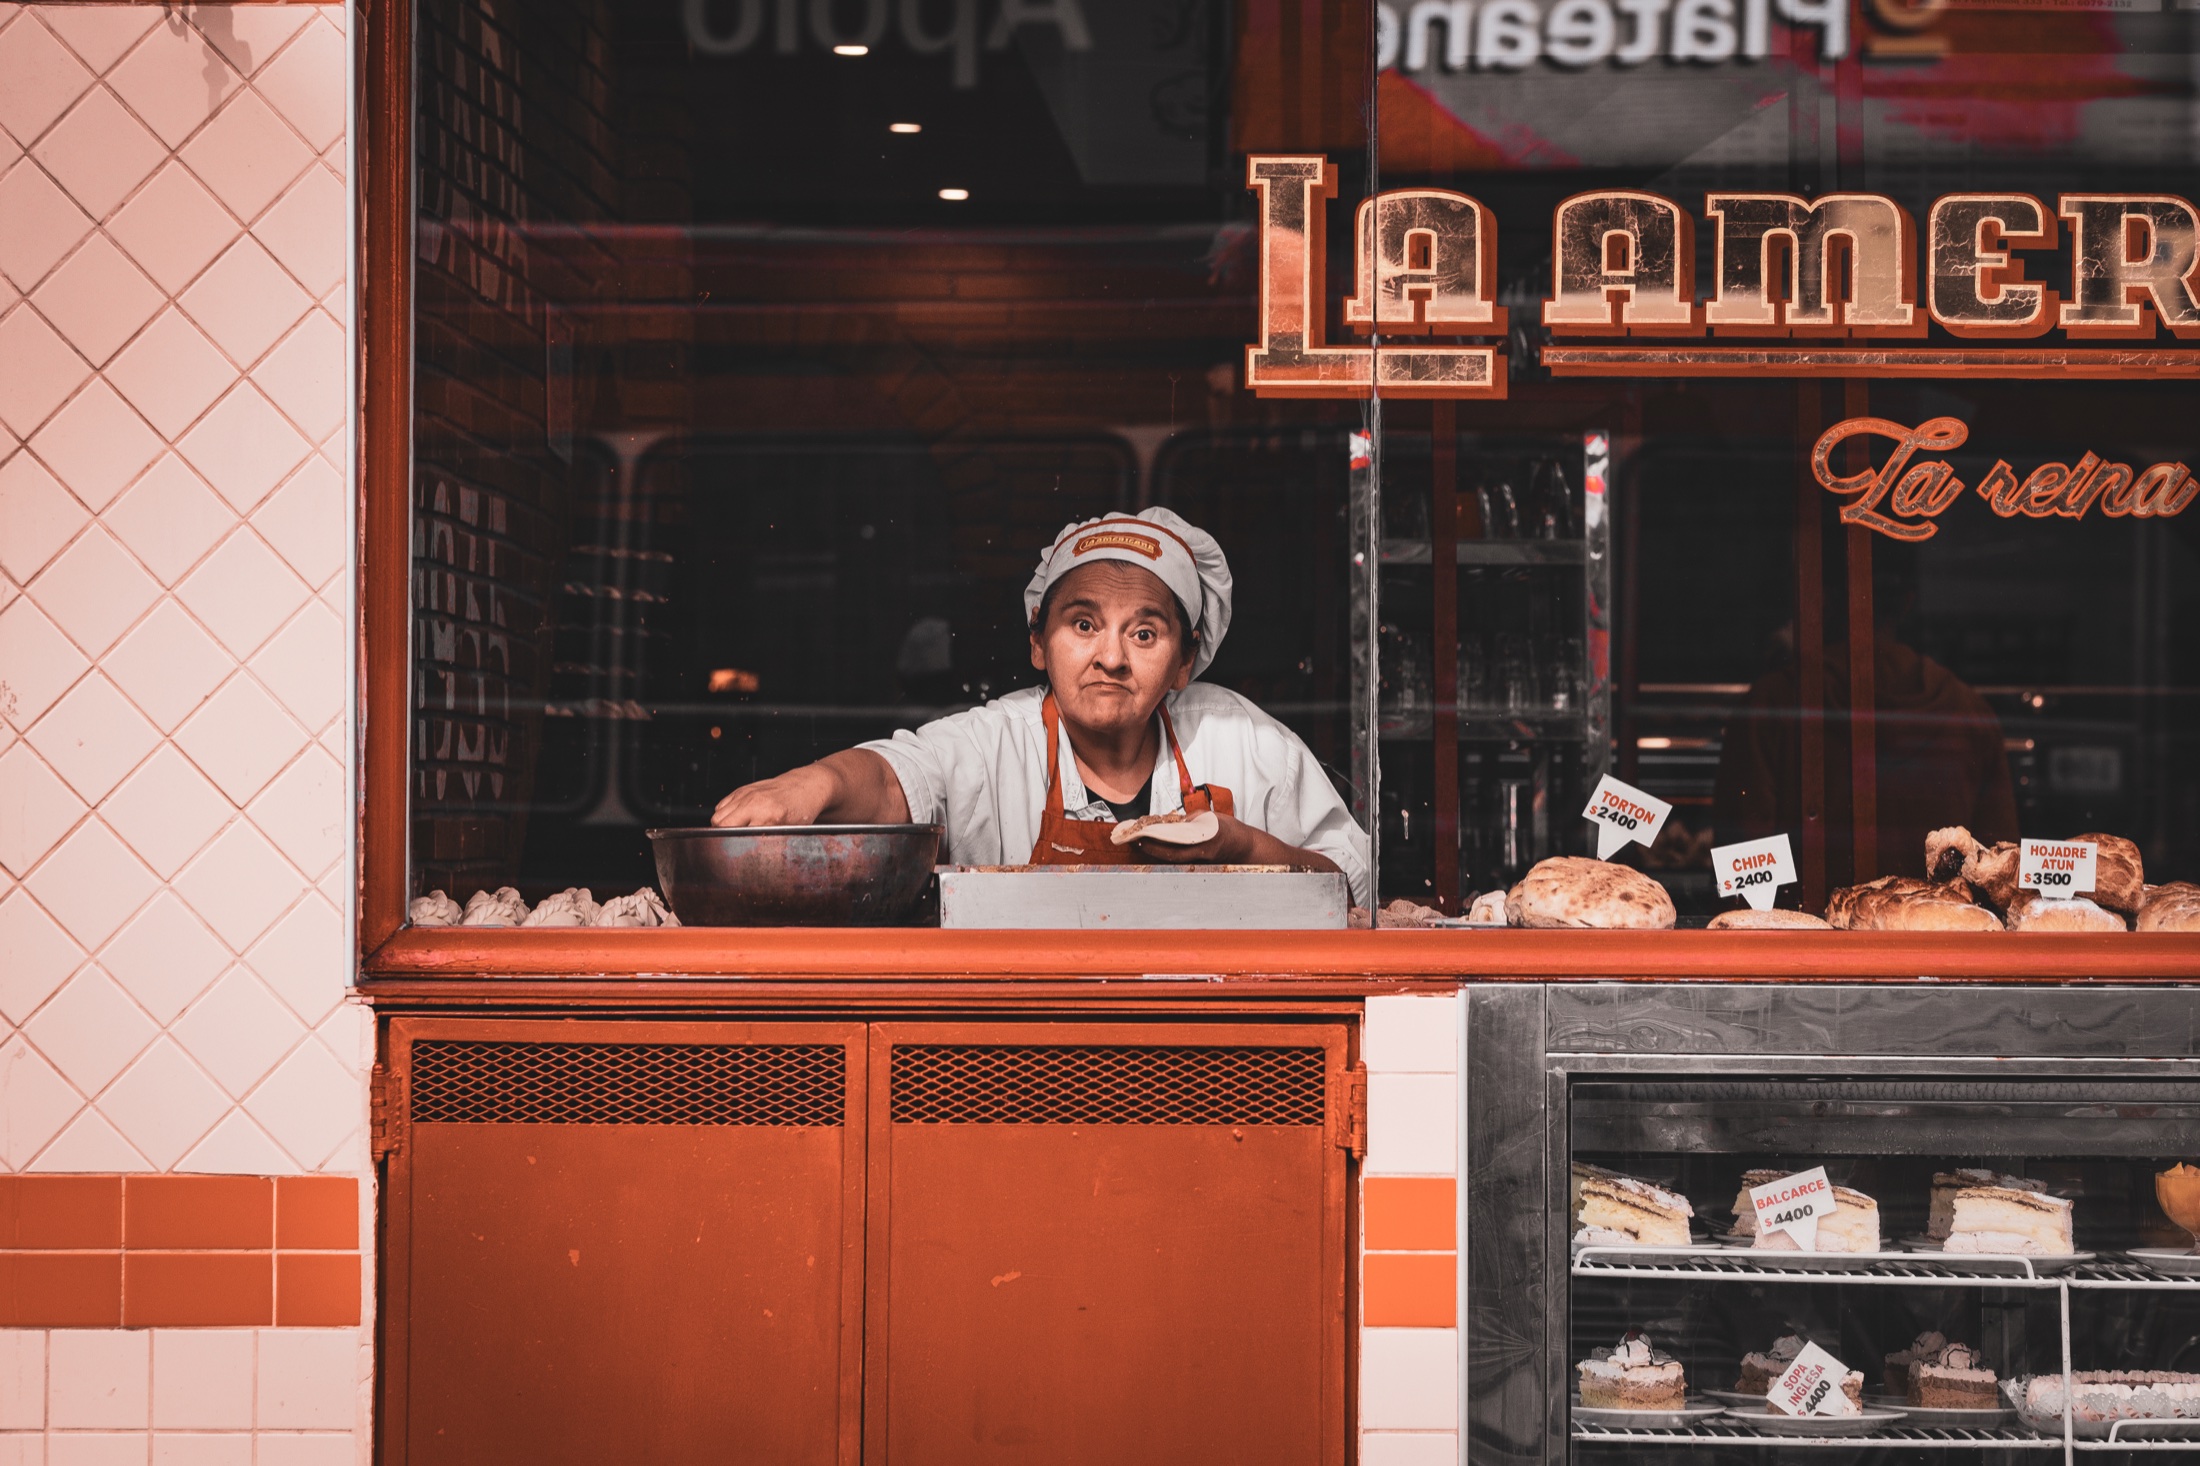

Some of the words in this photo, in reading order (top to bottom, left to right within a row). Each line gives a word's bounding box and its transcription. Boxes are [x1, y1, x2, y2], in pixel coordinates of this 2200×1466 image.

[1811, 416, 1968, 542] La
[1976, 449, 2200, 521] reina
[1602, 790, 1656, 825] TORTON
[1732, 852, 1776, 872] CHIPA
[2030, 845, 2087, 859] HOJADRE
[2041, 859, 2075, 871] ATUN
[1756, 1179, 1826, 1210] BALCARCE
[1783, 1363, 1808, 1390] SOPA
[1788, 1364, 1826, 1406] INGLESA
